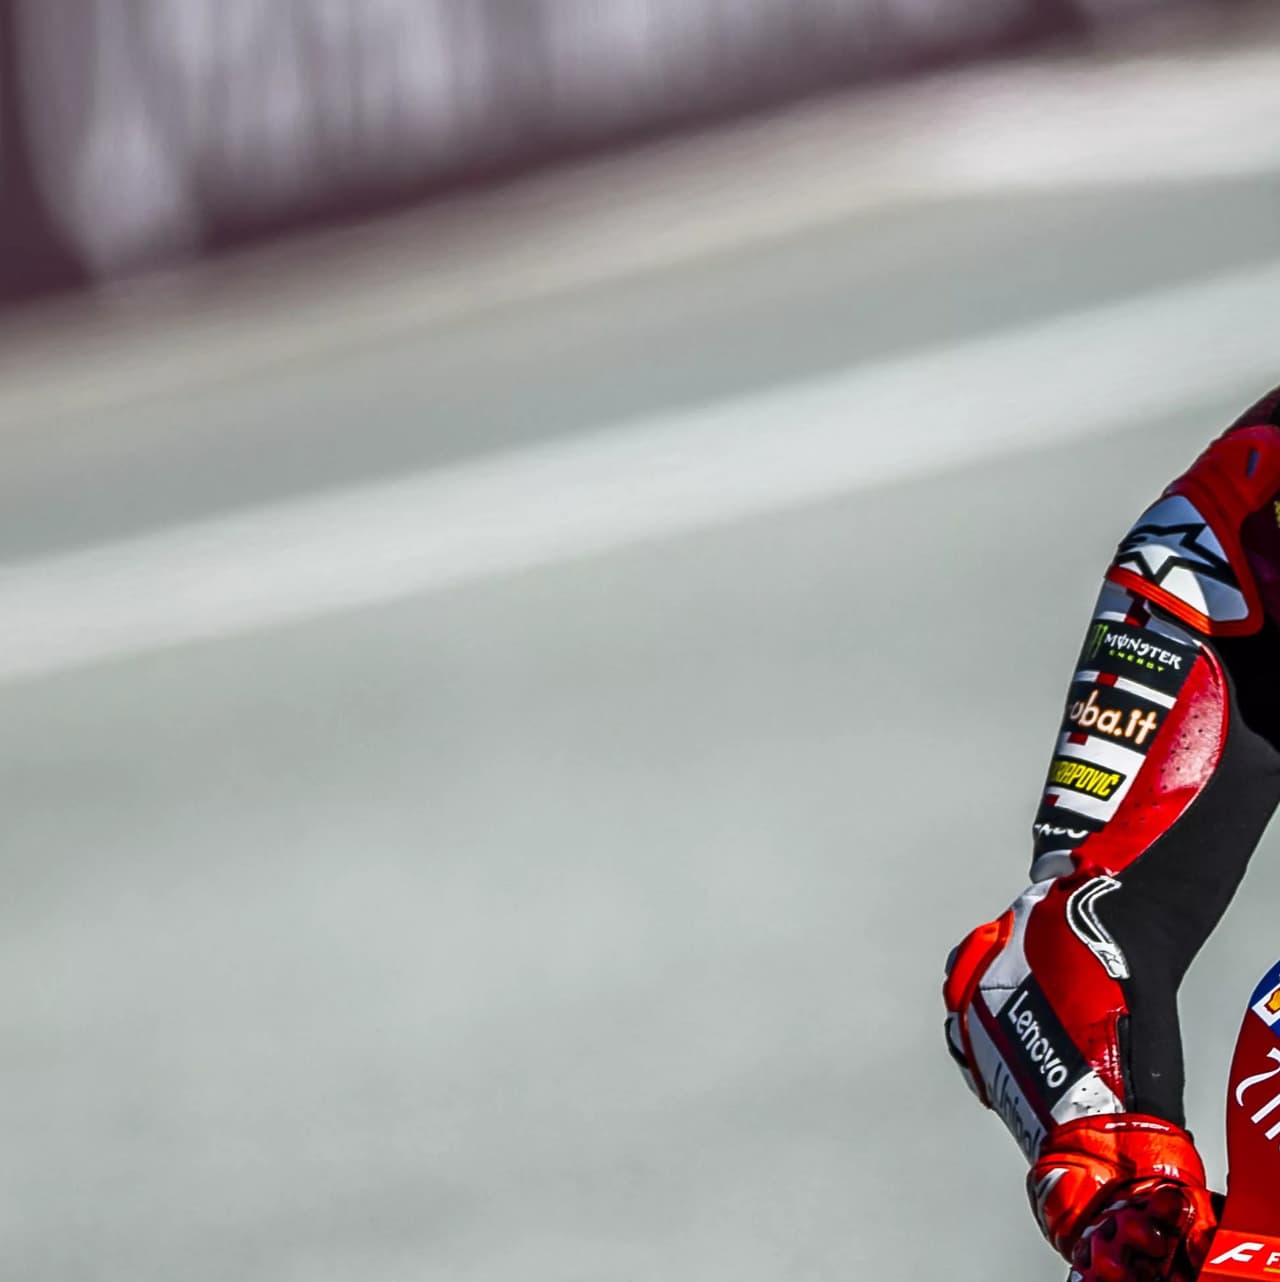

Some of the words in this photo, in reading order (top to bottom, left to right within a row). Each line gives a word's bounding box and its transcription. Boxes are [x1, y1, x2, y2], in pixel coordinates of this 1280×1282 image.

[1103, 632, 1183, 671] MONSTER
[1068, 690, 1158, 746] uba.it
[1006, 990, 1069, 1089] Lenovo
